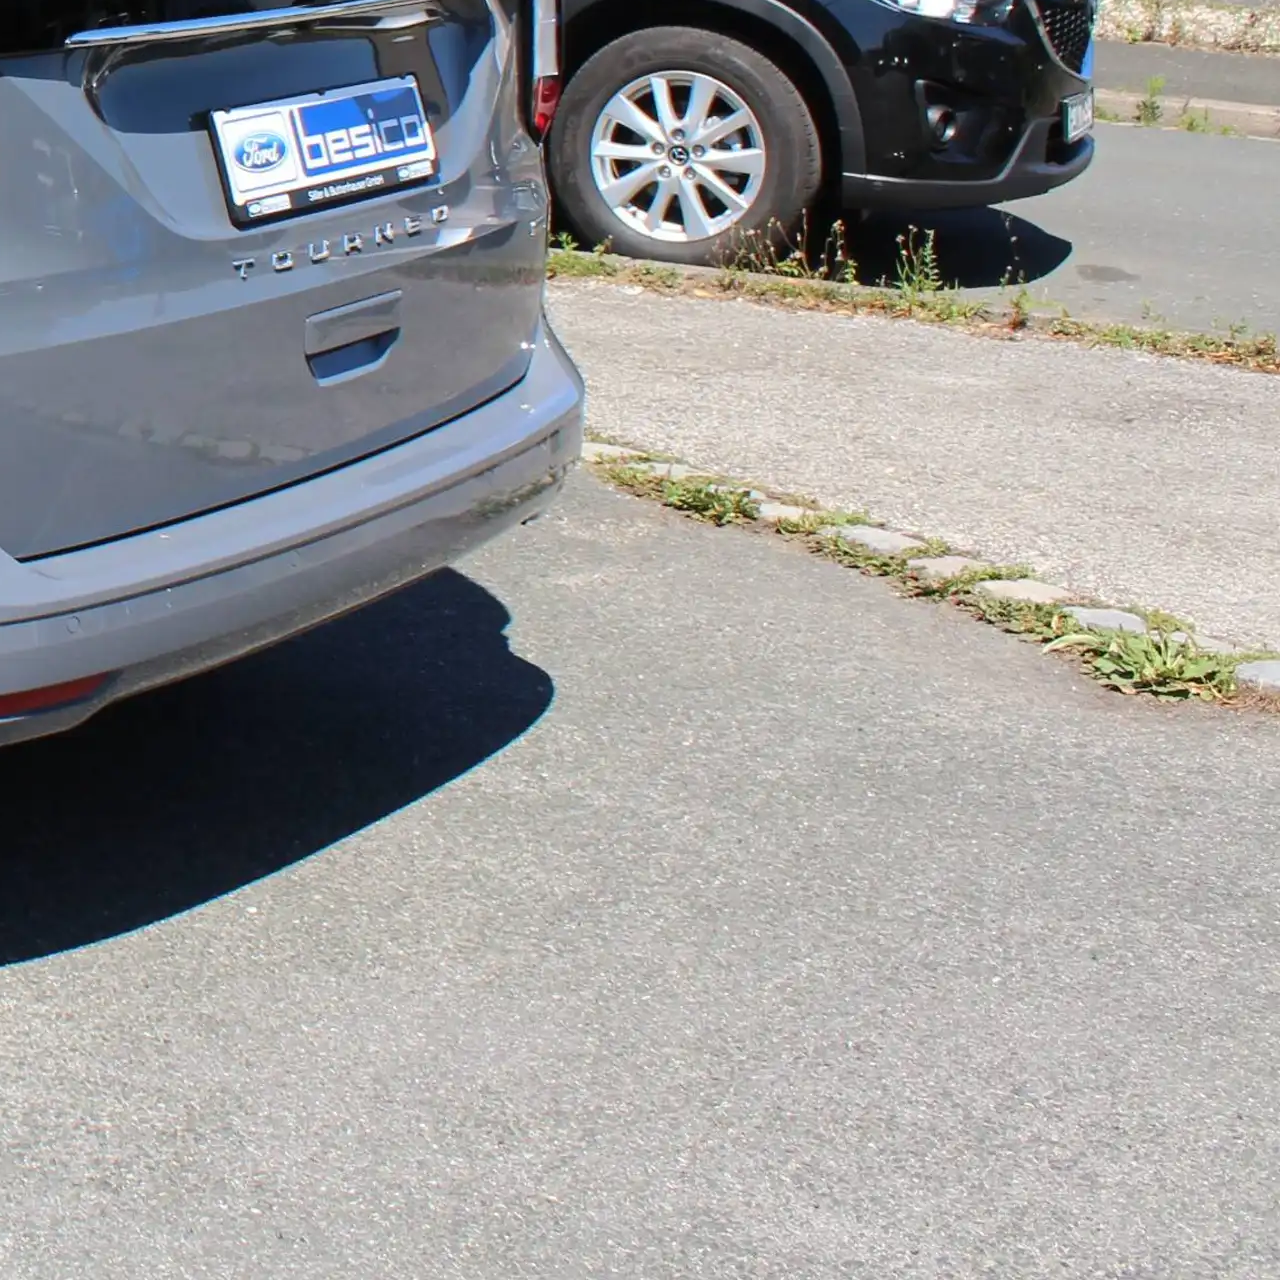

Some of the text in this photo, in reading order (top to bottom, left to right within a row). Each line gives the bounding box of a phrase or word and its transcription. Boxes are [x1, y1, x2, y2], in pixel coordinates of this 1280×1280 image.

[242, 107, 426, 169] Ford besico
[232, 205, 449, 282] TOURNEO
